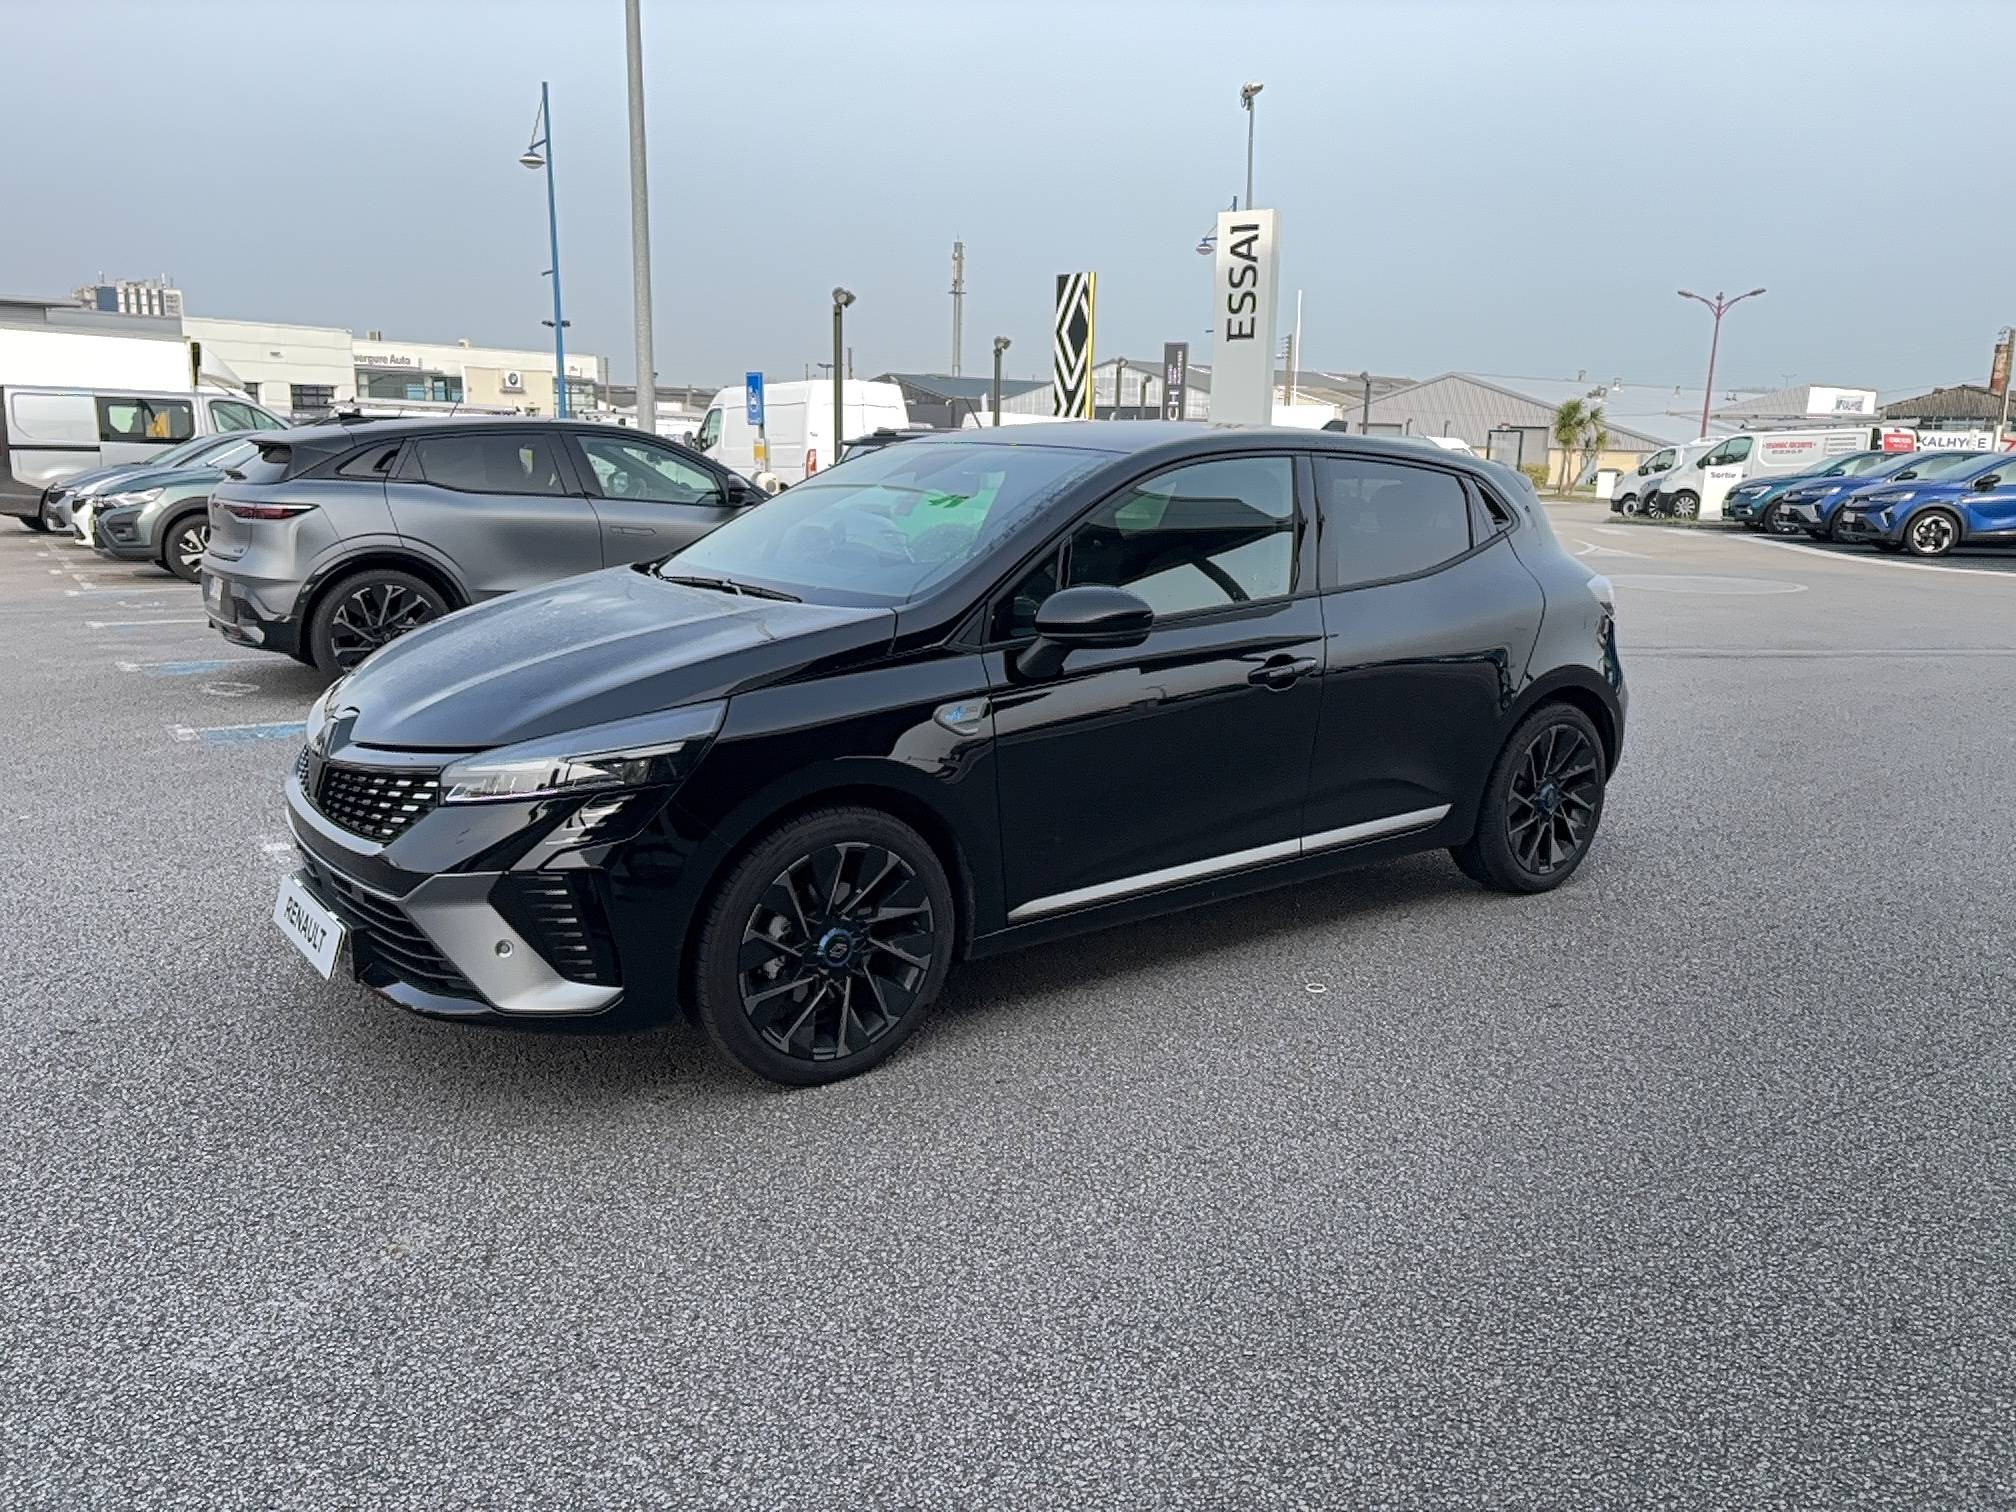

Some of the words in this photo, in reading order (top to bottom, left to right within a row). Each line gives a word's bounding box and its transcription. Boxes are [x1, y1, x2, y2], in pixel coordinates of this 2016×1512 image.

[1227, 224, 1259, 342] ESSAI
[389, 354, 411, 365] Auto
[1710, 471, 1737, 479] Sortie
[284, 896, 327, 953] RENAULT
